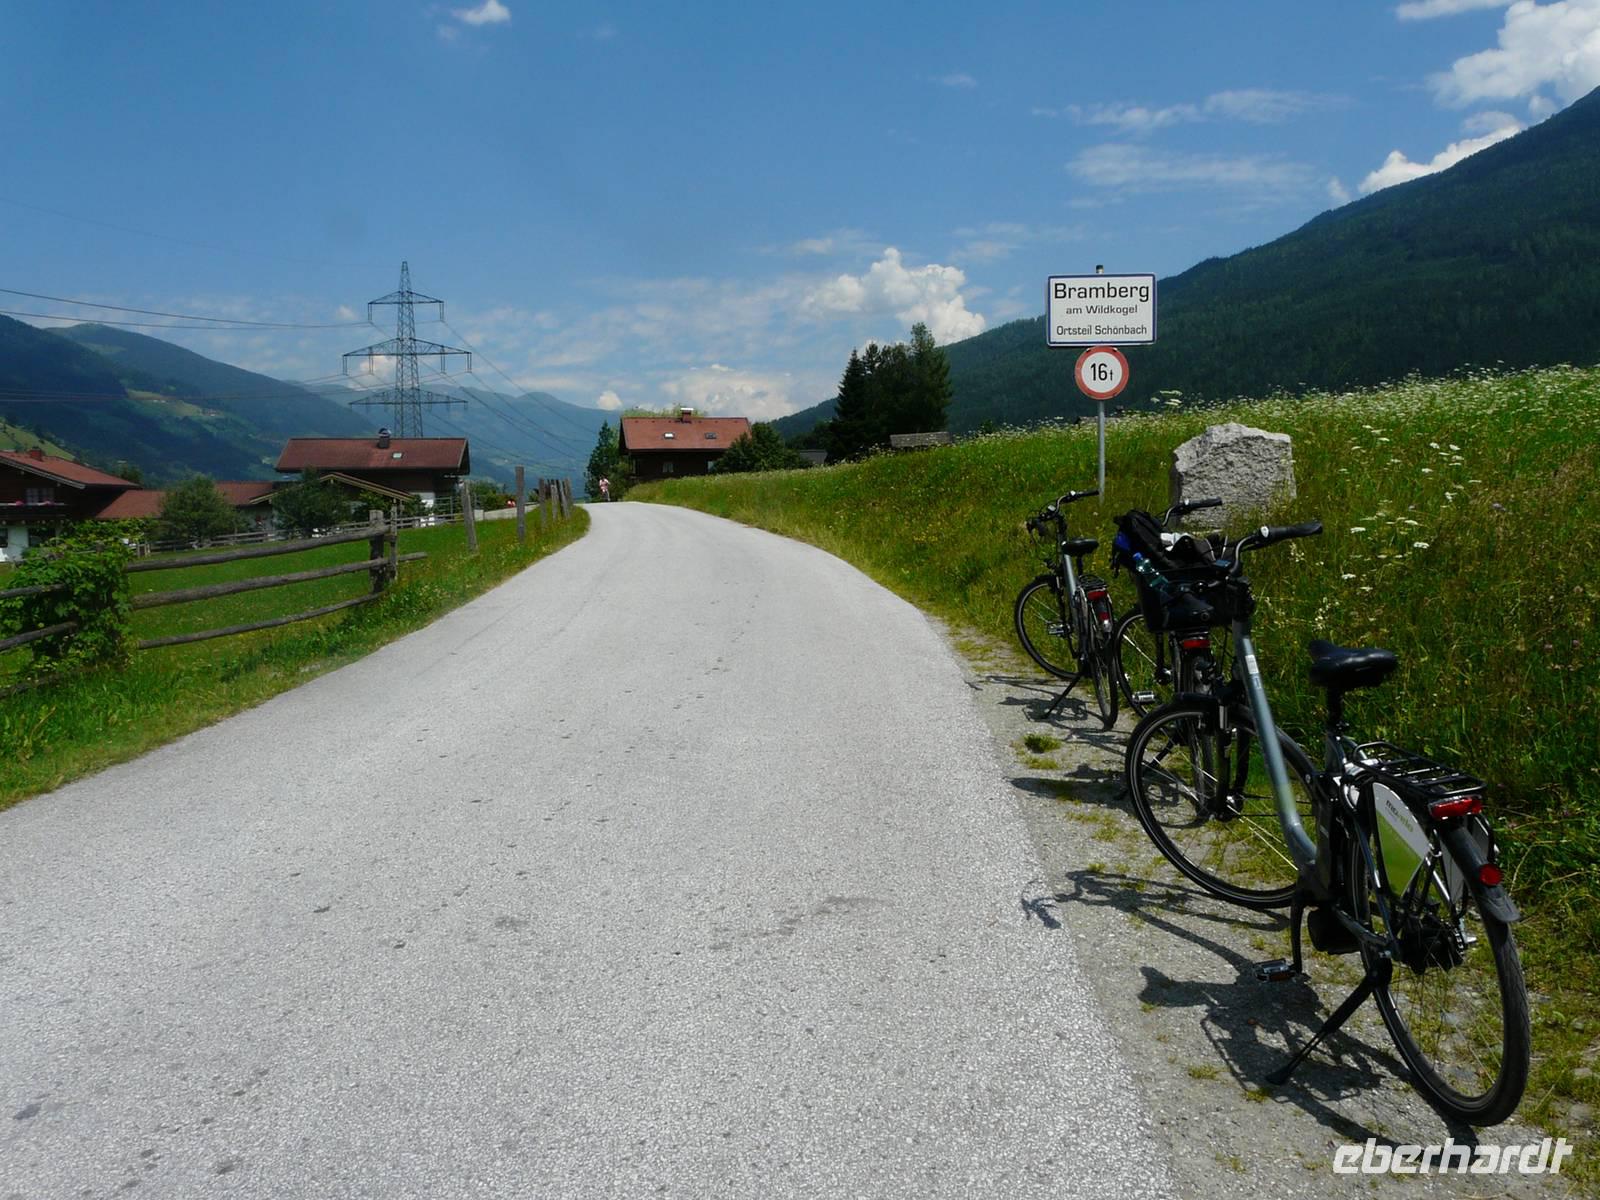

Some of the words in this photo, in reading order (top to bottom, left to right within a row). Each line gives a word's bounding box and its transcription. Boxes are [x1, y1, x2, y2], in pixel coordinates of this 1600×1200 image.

[1054, 281, 1149, 303] Bramberg
[1066, 307, 1082, 315] am
[1085, 304, 1138, 316] Wildkogel
[1056, 324, 1092, 336] Ortsteil
